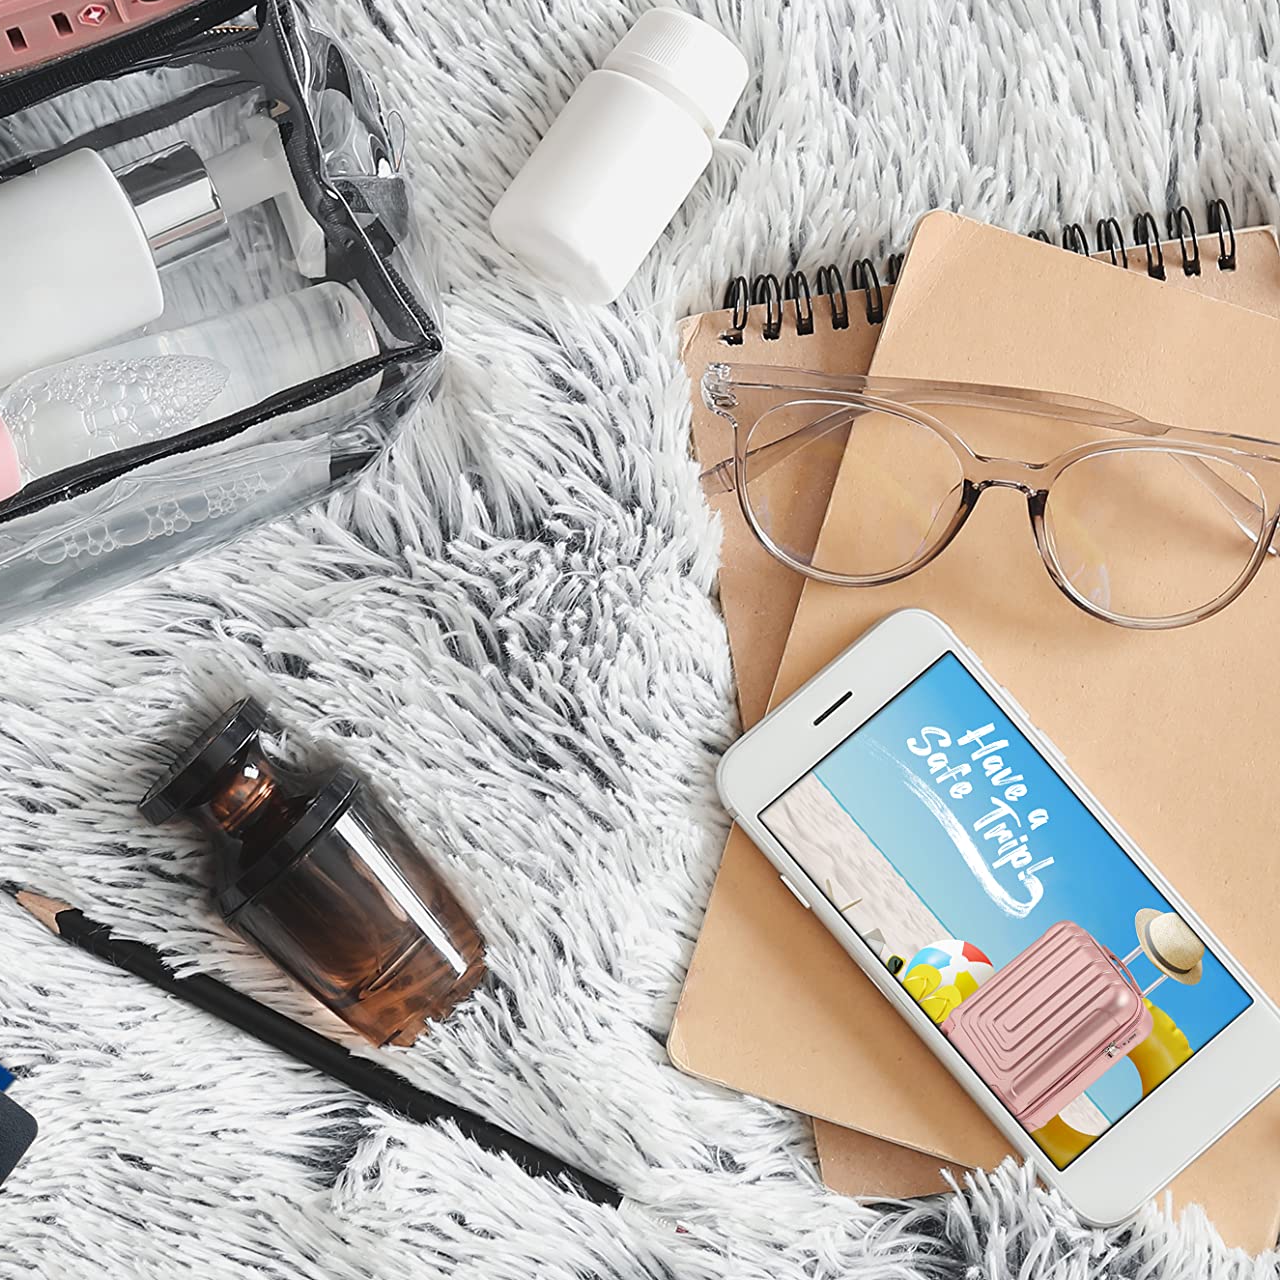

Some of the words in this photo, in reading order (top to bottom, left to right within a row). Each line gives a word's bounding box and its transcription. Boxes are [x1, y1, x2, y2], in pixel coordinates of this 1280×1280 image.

[906, 726, 973, 800] Safe
[973, 796, 1055, 881] Trip!
[957, 722, 1028, 802] Have
[1027, 808, 1049, 831] a
